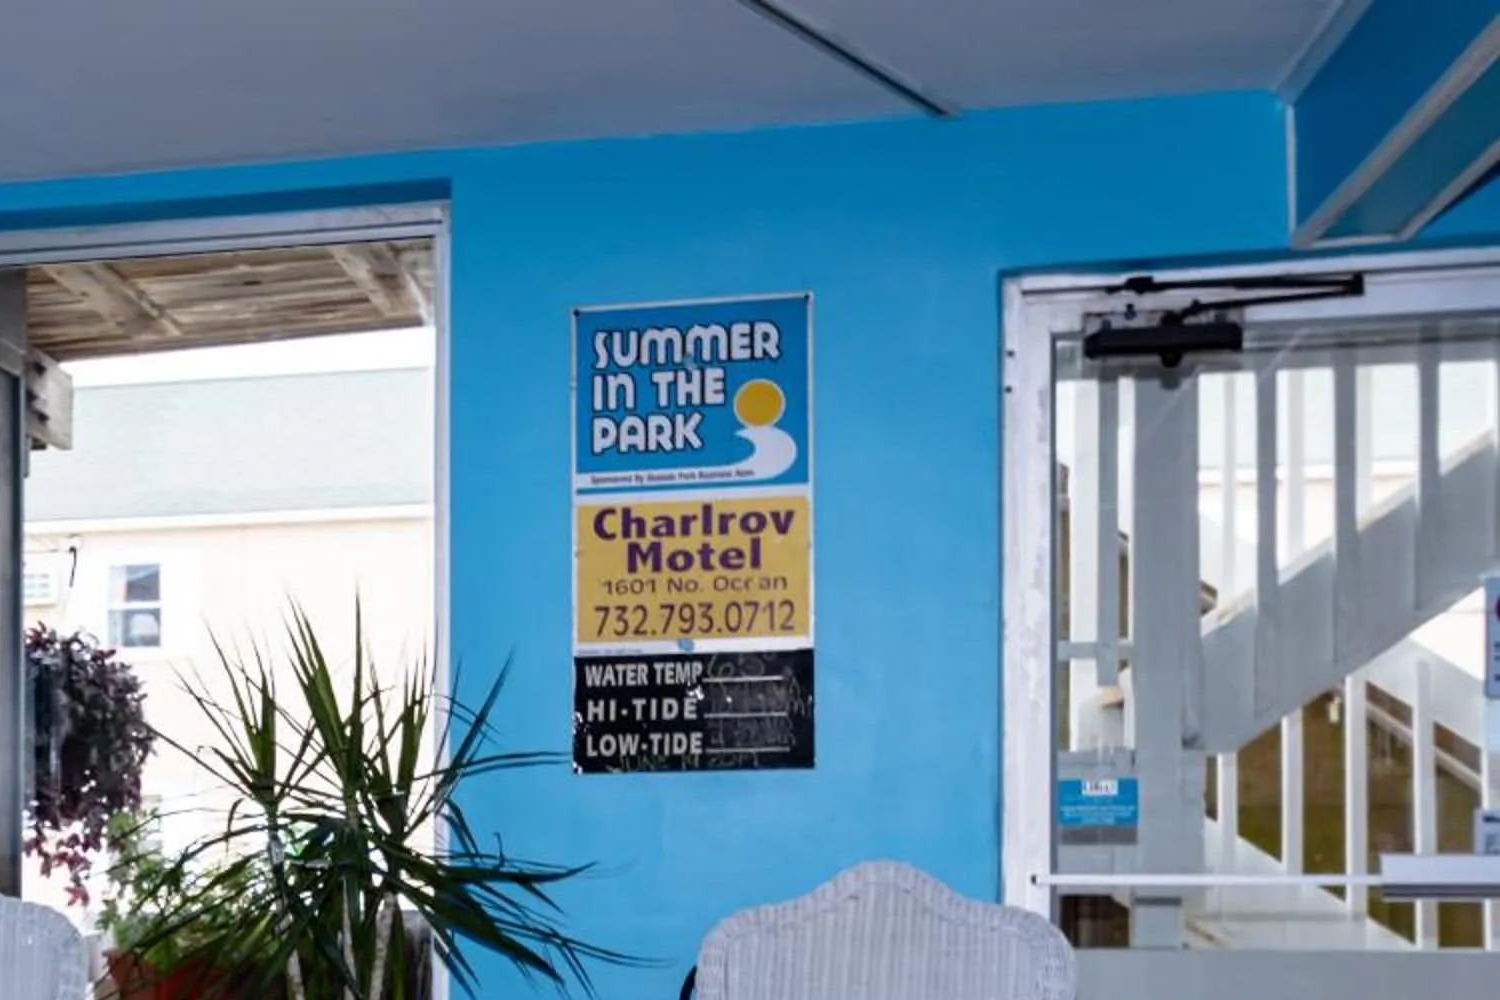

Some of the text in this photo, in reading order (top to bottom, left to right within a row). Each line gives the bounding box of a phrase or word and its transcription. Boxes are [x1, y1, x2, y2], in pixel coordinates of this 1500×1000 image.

[593, 321, 781, 370] SUMMER
[592, 366, 726, 412] IN THE
[592, 411, 704, 455] PARK
[626, 536, 763, 574] Motel
[602, 578, 657, 595] 1601
[594, 599, 796, 638] 732.793.0712
[584, 660, 703, 688] WATER TEMP
